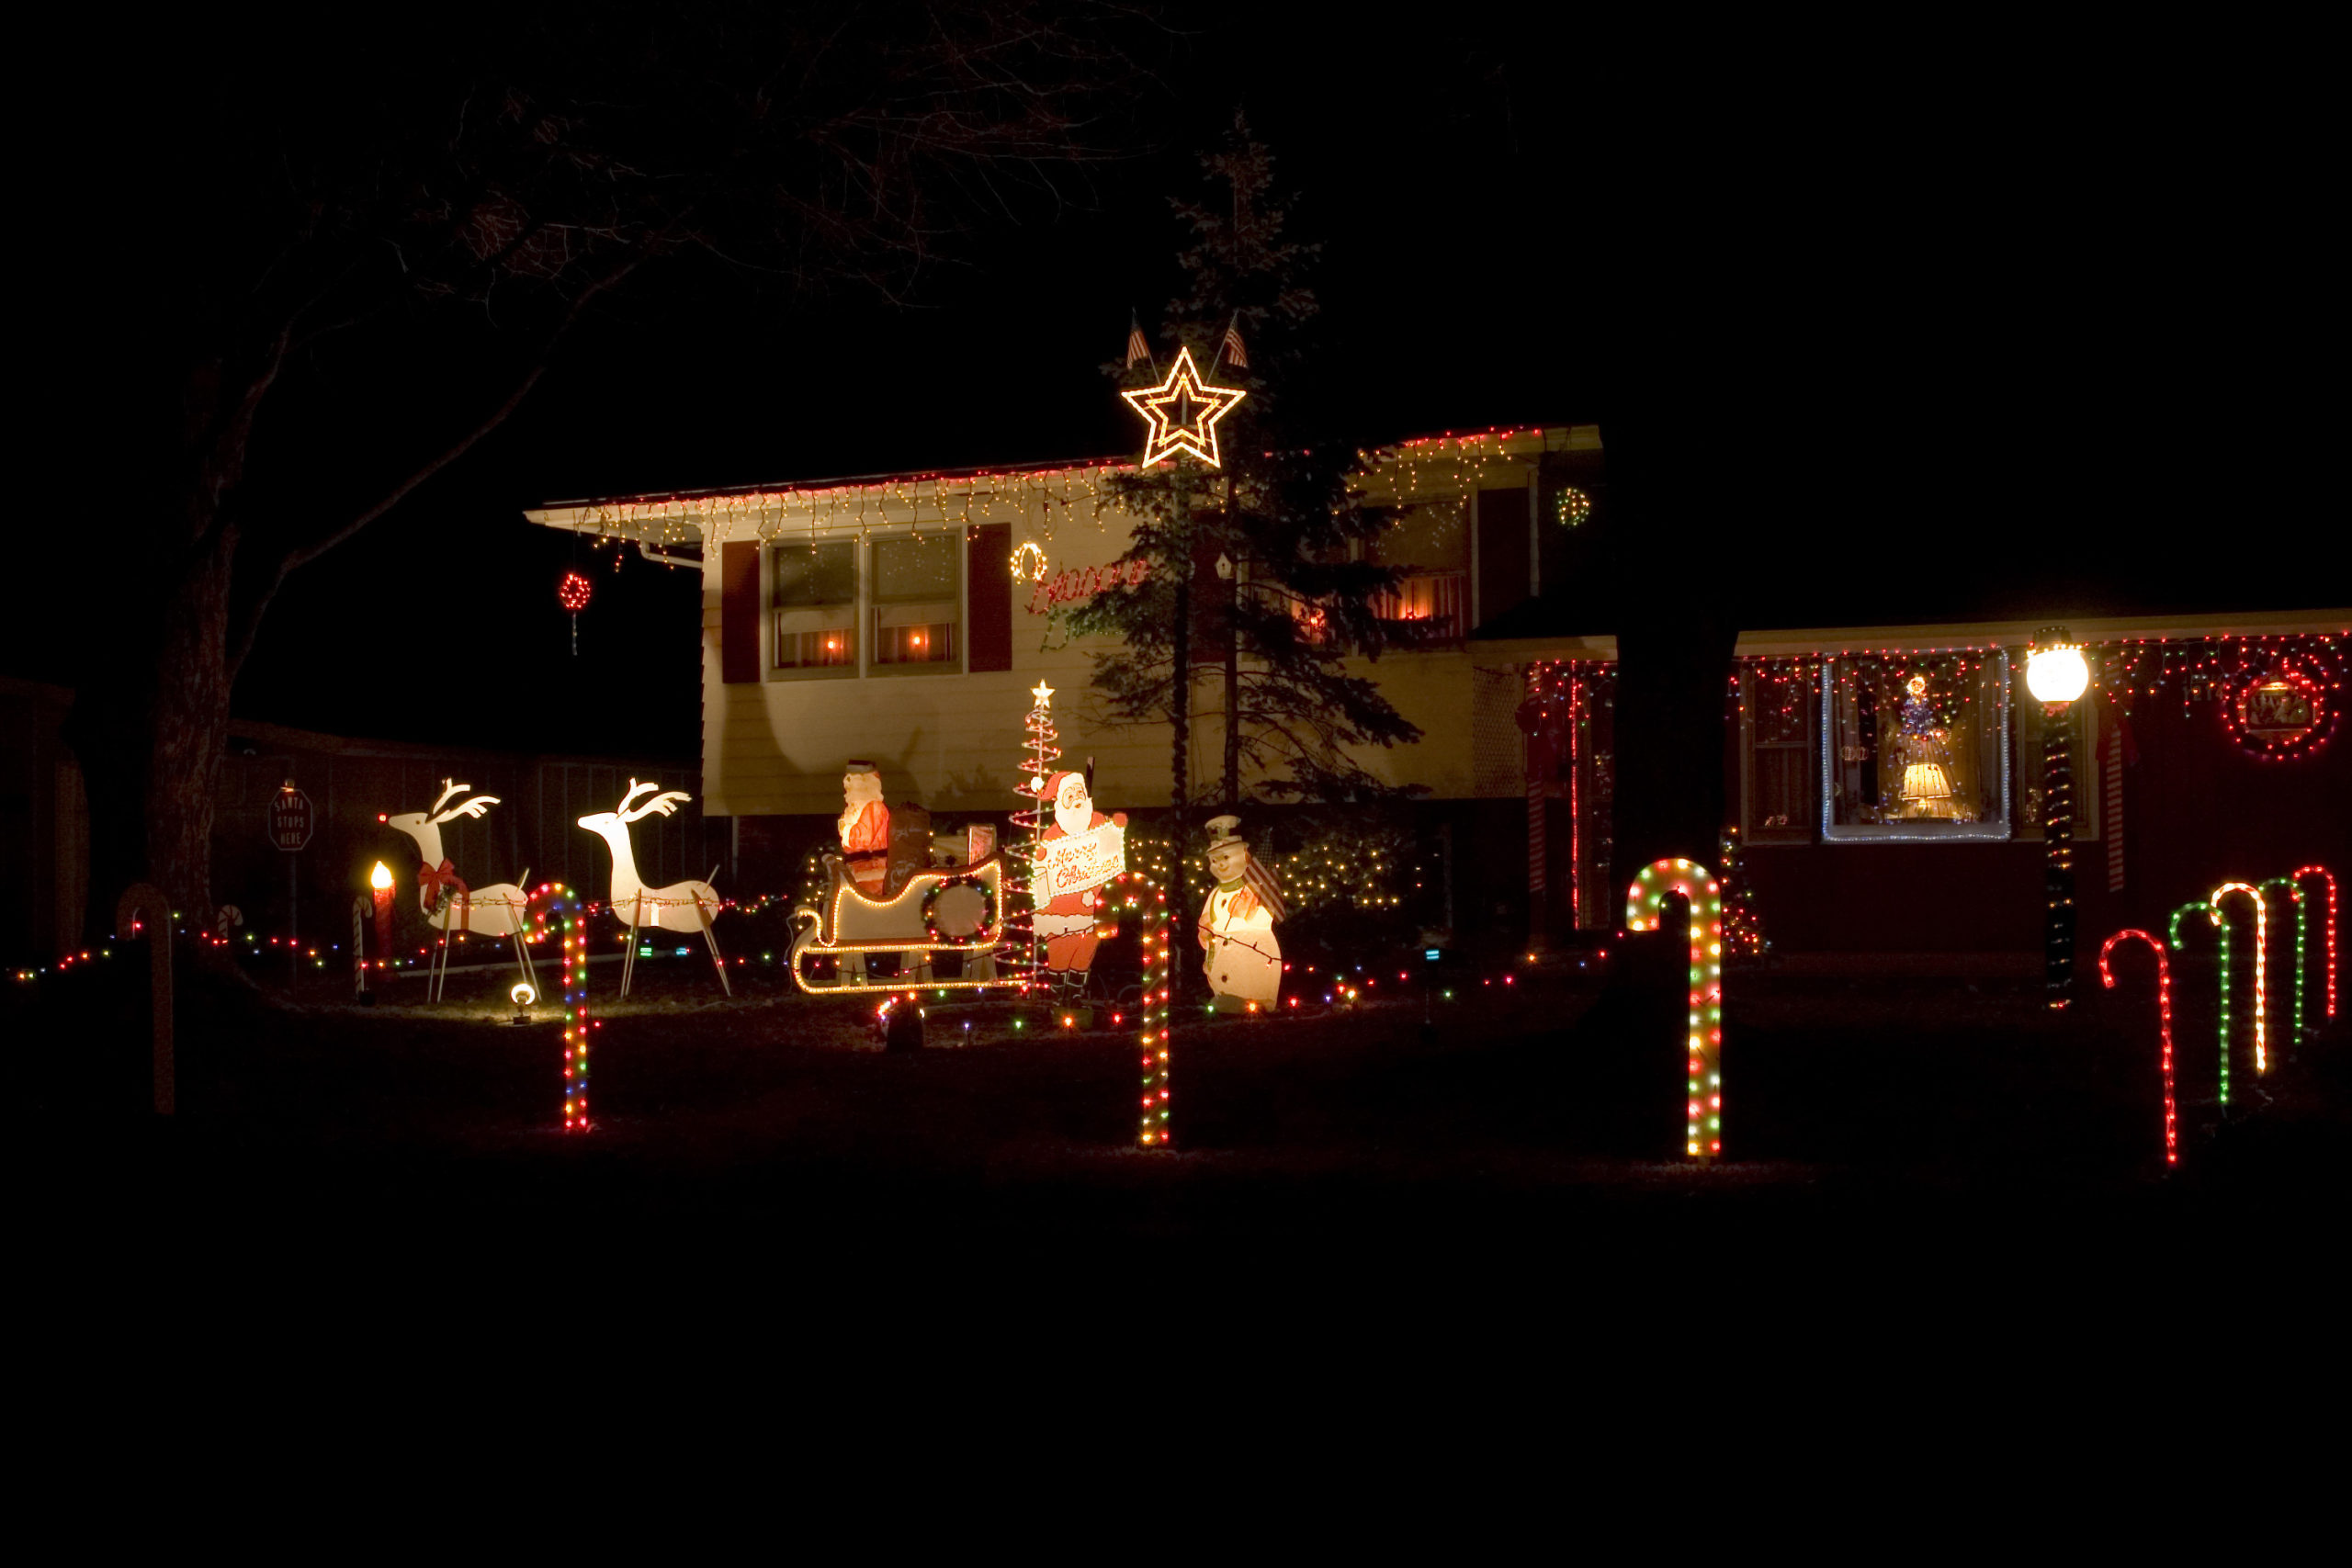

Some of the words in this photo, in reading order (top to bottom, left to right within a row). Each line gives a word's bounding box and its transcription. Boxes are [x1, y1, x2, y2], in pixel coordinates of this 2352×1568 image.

[274, 796, 304, 812] SANTA
[277, 815, 305, 829] STOPS
[280, 831, 301, 845] HERE
[1047, 842, 1096, 869] Merry
[1056, 854, 1119, 887] Christmas
